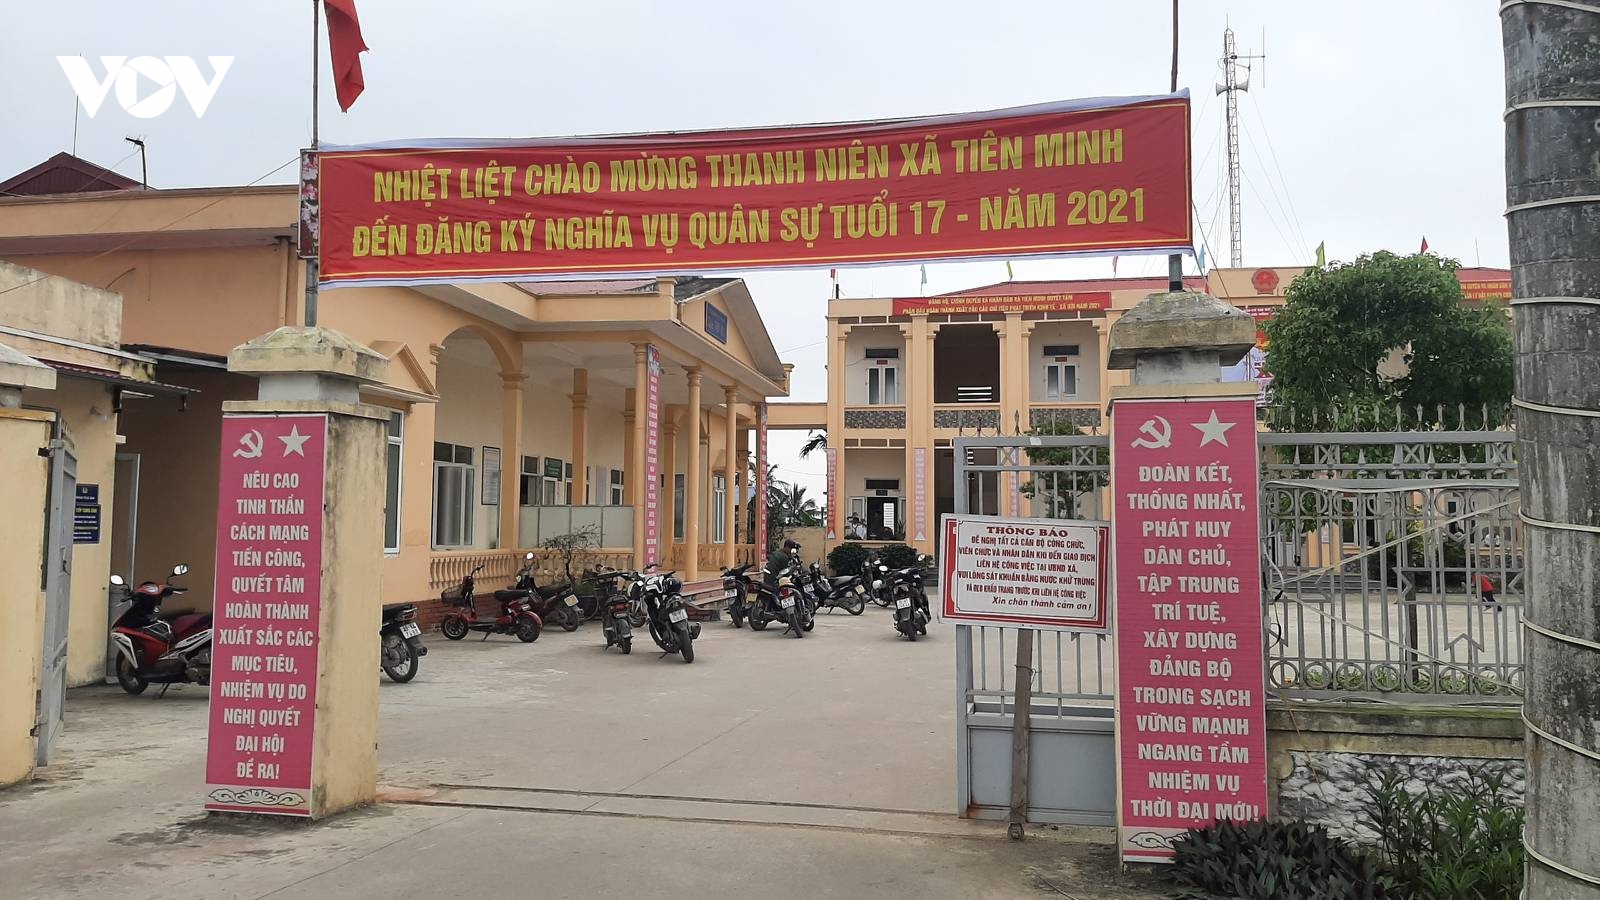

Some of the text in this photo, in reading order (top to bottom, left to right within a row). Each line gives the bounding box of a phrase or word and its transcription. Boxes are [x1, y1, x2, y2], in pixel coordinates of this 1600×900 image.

[374, 128, 1123, 207] NHIỆT LIỆT CHÀO MỪNG THANH NIÊN XÃ TIÊN MINH
[353, 215, 407, 256] ĐẾN
[416, 216, 491, 255] ĐĂNG
[500, 213, 535, 252] KÝ
[545, 210, 631, 250] NGHĨA
[641, 213, 679, 253] VỤ
[689, 203, 769, 248] QUÂN
[781, 204, 825, 248] SỰ
[829, 189, 898, 239] TUỔI
[909, 200, 946, 235] 17
[980, 187, 1055, 230] NĂM
[1067, 188, 1145, 226] 2021
[244, 471, 299, 489] NÊU CAO
[1139, 461, 1232, 484] ĐOÀN KẾT,
[237, 499, 266, 514] TINH
[1127, 488, 1245, 511] THỐNG NHẤT,
[231, 522, 309, 544] CÁCH MẠNG
[987, 526, 1068, 537] THÔNG BÁO
[1143, 518, 1231, 537] PHÁT HUY
[233, 546, 305, 568] TIẾN CÔNG,
[1144, 544, 1231, 567] DÂN CHỦ,
[232, 573, 304, 593] QUYẾT TÂM
[1138, 573, 1239, 595] TẬP TRUNG
[226, 600, 309, 619] HOÀN THÀNH
[1152, 601, 1226, 624] TRÍ TUỆ,
[219, 624, 313, 647] XUẤT SẮC CÁC
[1144, 629, 1237, 652] XÂY DỰNG
[232, 654, 297, 675] MỤC TIÊU,
[1150, 655, 1232, 681] ĐẢNG BỘ
[221, 680, 306, 702] NHIỆM VỤ DO
[1133, 687, 1251, 709] TRONG SẠCH
[224, 706, 300, 728] NGHỊ QUYẾT
[1137, 712, 1249, 738] VỮNG MẠNH
[236, 733, 284, 756] ĐẠI HỘI
[1138, 741, 1249, 763] NGANG TẦM
[258, 763, 279, 779] RA!
[1149, 770, 1240, 795] NHIỆM VỤ
[1131, 797, 1259, 823] THỜI ĐẠI MỚI!
